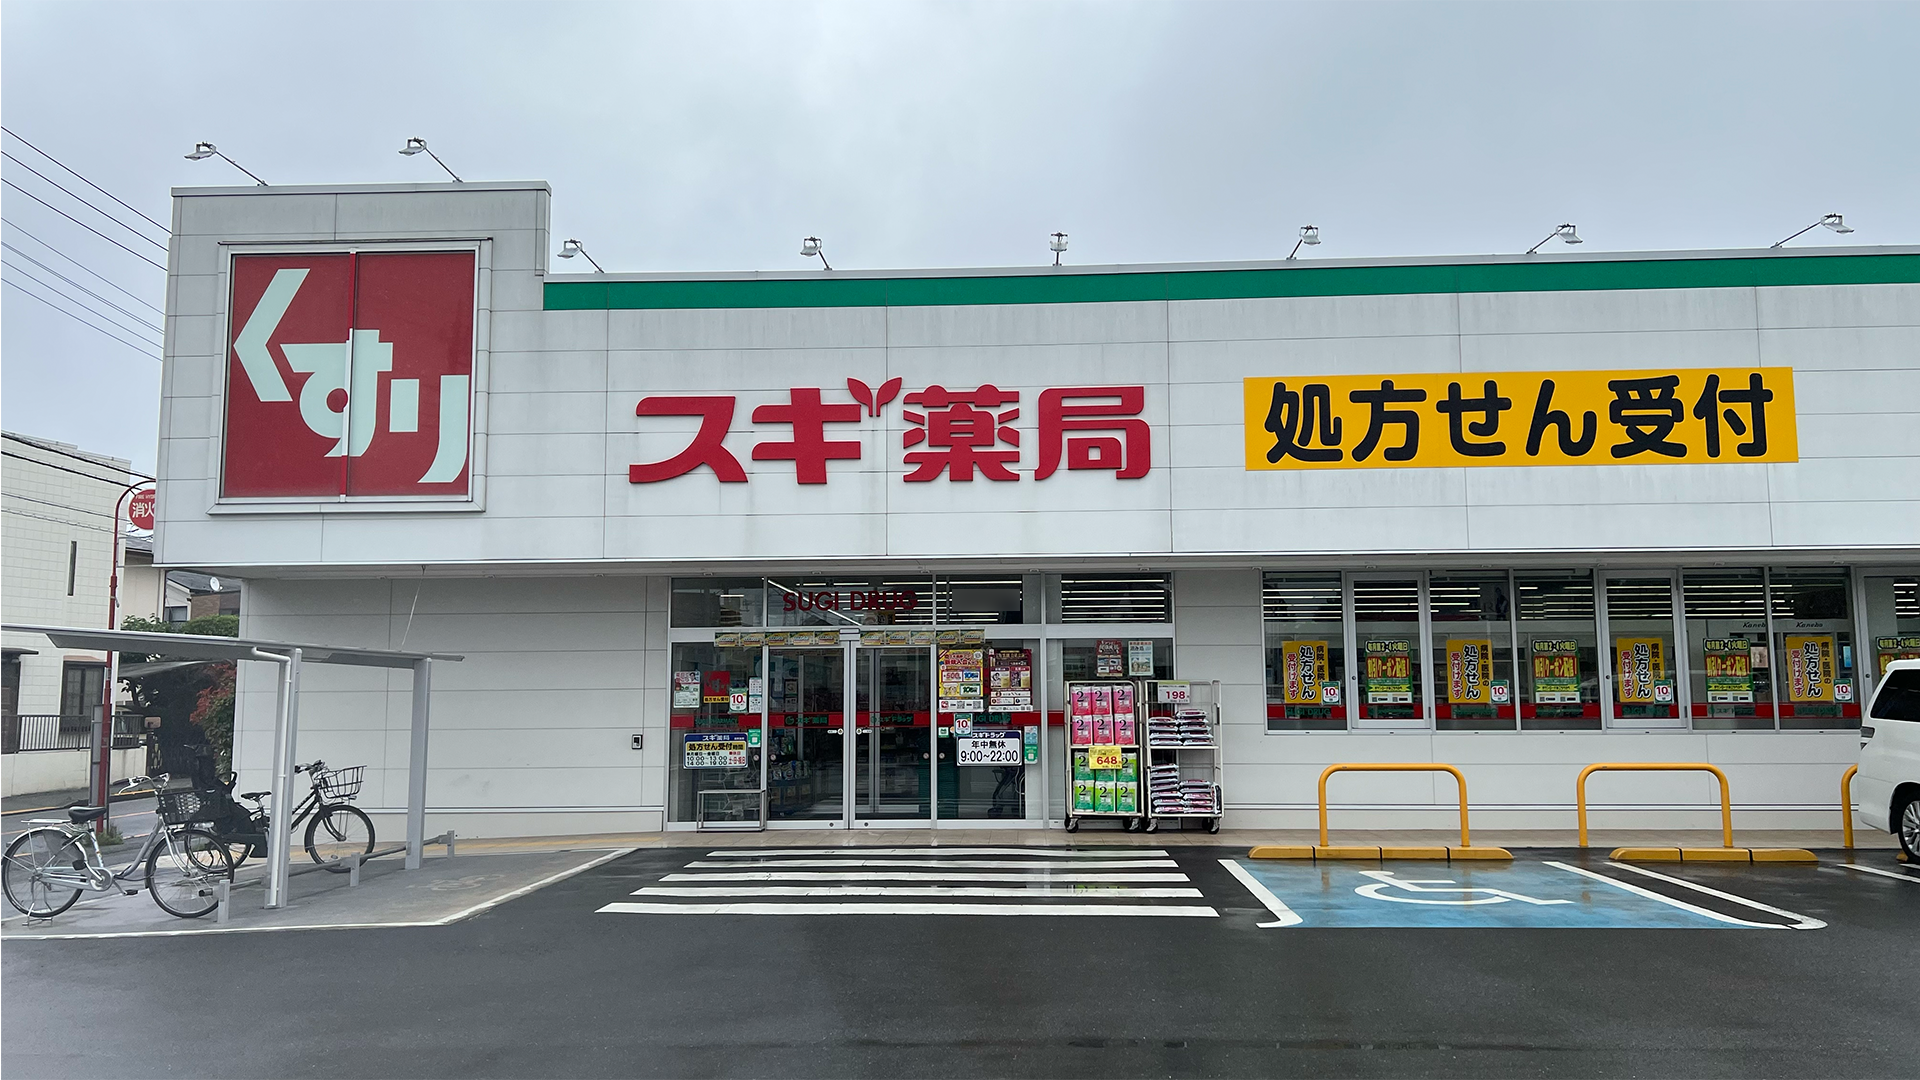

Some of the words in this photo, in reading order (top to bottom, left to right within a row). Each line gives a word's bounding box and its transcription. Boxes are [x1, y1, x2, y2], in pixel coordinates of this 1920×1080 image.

[233, 268, 469, 483] くすり
[1264, 373, 1774, 464] 処方せん受付
[629, 377, 1151, 484] スギ薬局
[132, 502, 155, 518] 消火
[783, 591, 839, 611] SUGI
[850, 590, 918, 611] DRUG
[1480, 644, 1490, 687] 病院・医院の
[1634, 643, 1651, 699] 処方せん
[1804, 641, 1822, 698] 処方せん
[1821, 642, 1831, 684] 病院・医院の
[1286, 653, 1299, 699] 受付けます
[1299, 645, 1316, 700] 処方せん
[1451, 652, 1462, 699] 受付けます
[1463, 644, 1481, 700] 処方せん
[1621, 651, 1633, 698] 受付けます
[1791, 650, 1803, 697] 受付けます
[1077, 691, 1084, 702] 2
[1095, 690, 1102, 701] 2
[1118, 689, 1125, 700] 2
[1166, 691, 1186, 699] 198
[1077, 720, 1084, 730] 2
[1097, 719, 1104, 730] 2
[1120, 720, 1127, 731] 2
[972, 741, 1007, 749] 年中無休
[1079, 756, 1086, 767] 2
[1097, 756, 1117, 765] 648
[1122, 757, 1129, 768] 2
[1079, 785, 1086, 796] 2
[1100, 786, 1107, 797] 2
[1121, 786, 1128, 797] 2
